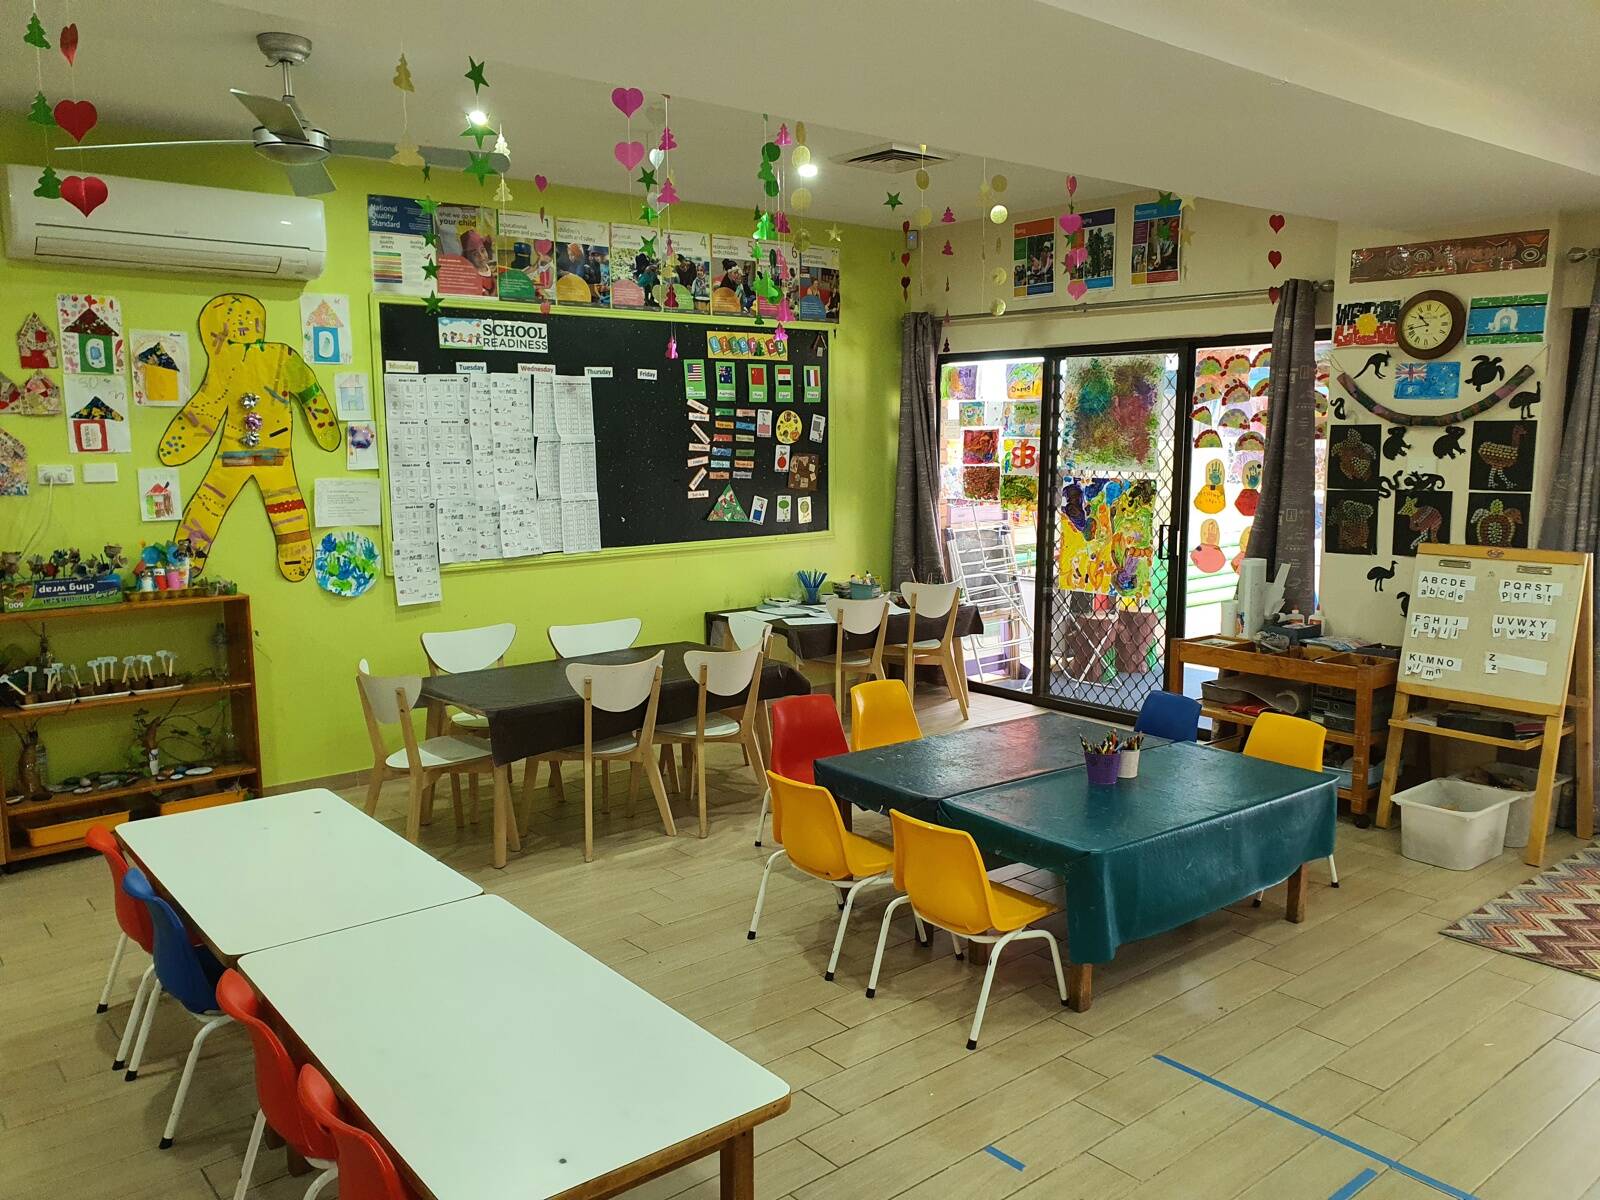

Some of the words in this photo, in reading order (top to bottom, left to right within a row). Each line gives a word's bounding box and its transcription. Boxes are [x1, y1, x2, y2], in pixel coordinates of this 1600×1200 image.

[370, 204, 398, 212] National
[370, 211, 395, 221] Quality
[371, 219, 401, 229] Standard
[458, 219, 477, 228] child
[699, 236, 706, 250] 4
[791, 246, 798, 259] 6
[483, 324, 547, 339] SCHOOL
[483, 338, 548, 350] READINESS
[388, 362, 417, 372] Monday
[459, 364, 485, 373] Tuesday
[520, 366, 554, 374] Wednesday
[586, 368, 612, 377] Thursday
[639, 370, 656, 380] Friday
[38, 584, 66, 594] wrap
[69, 583, 95, 594] cling
[8, 601, 24, 609] 600
